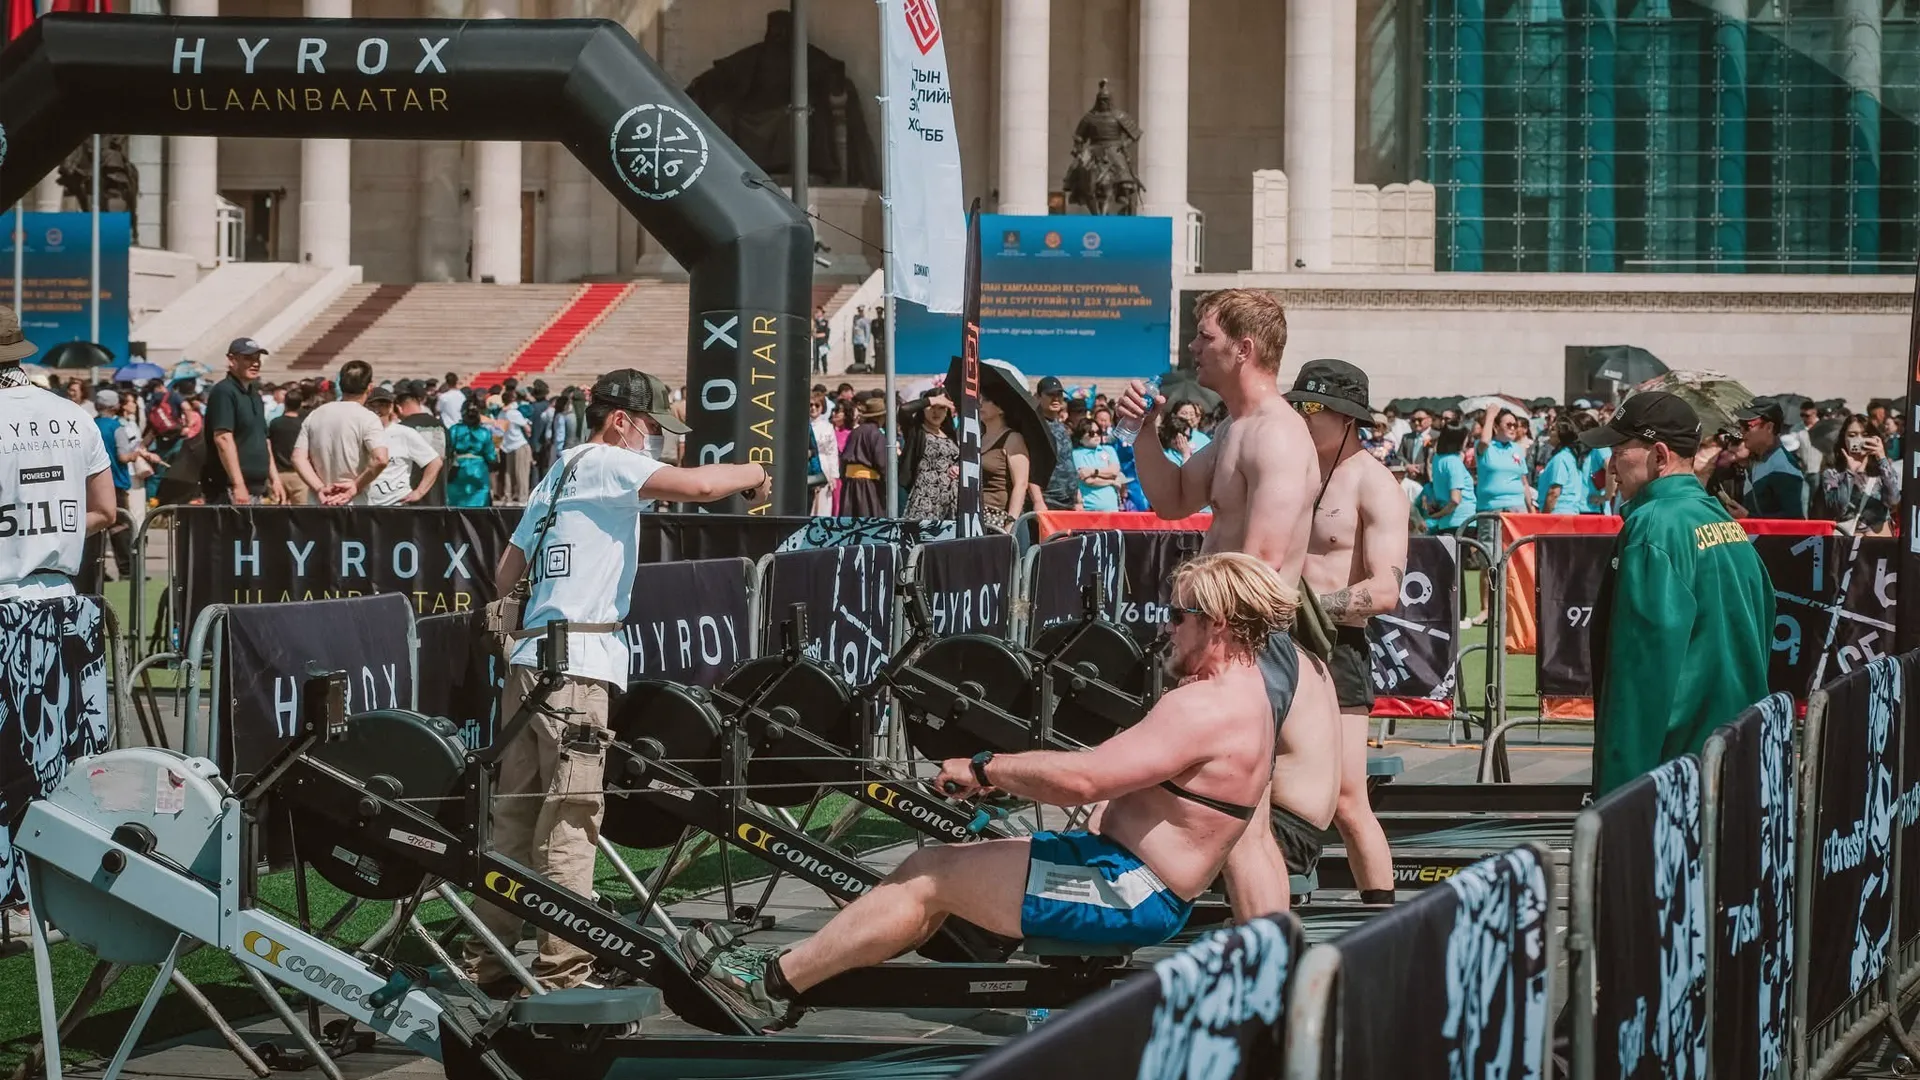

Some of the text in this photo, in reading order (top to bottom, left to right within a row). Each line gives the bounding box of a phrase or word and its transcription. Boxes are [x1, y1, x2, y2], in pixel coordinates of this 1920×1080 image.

[172, 37, 450, 75] HYROX
[173, 88, 450, 111] ULAANBAATAR
[0, 419, 79, 439] YROX
[52, 470, 61, 478] BY
[234, 540, 472, 579] HYROX
[275, 663, 398, 738] HOX
[522, 891, 656, 968] concept 2
[412, 1018, 436, 1042] 2
